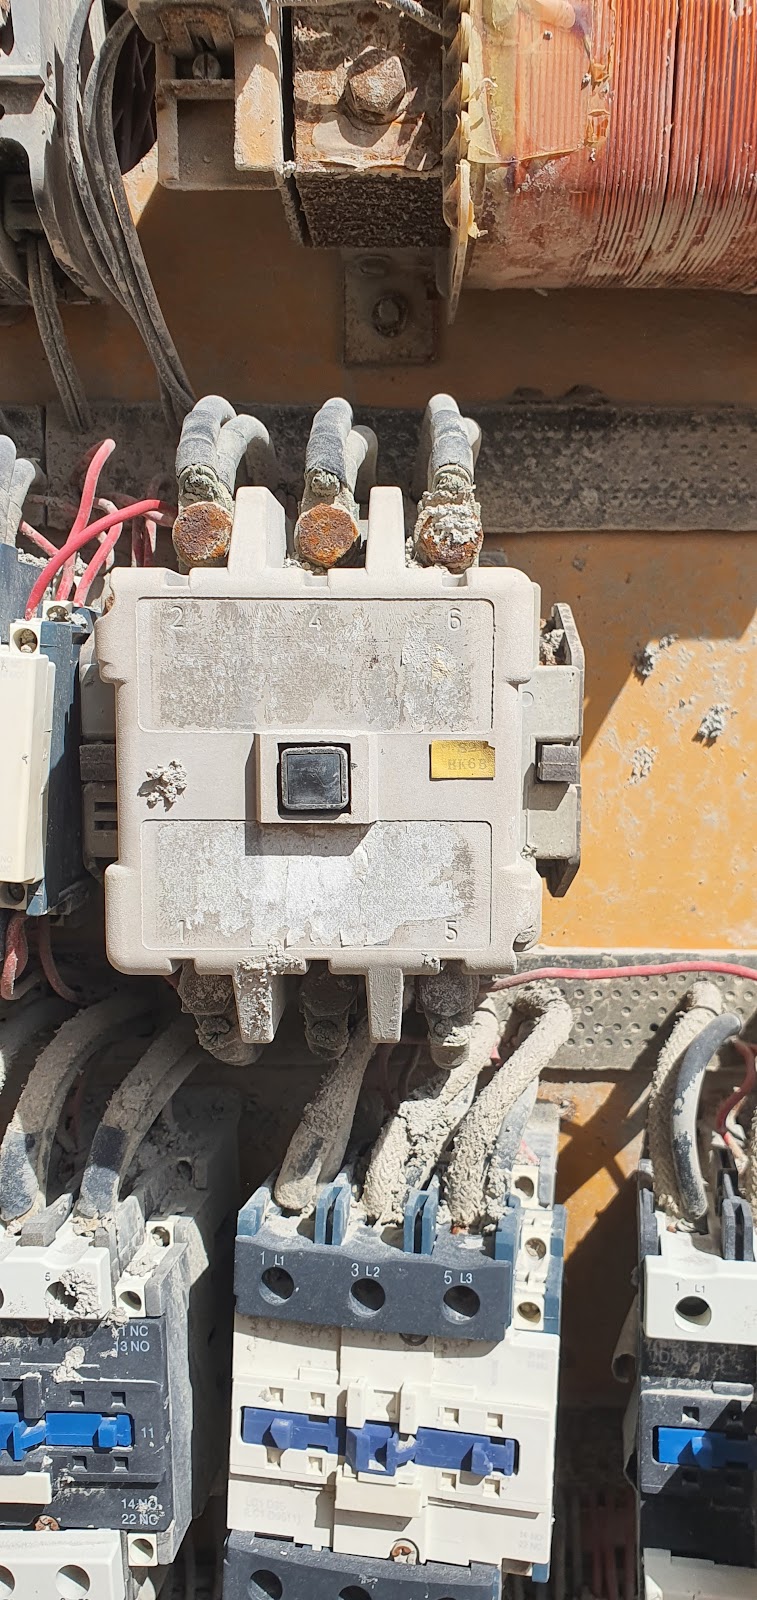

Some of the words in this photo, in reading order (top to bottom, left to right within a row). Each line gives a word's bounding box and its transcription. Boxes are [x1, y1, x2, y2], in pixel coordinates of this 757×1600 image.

[169, 606, 185, 630] 2
[308, 607, 323, 632] 4
[448, 607, 463, 632] 6
[444, 920, 458, 943] 5
[260, 1251, 266, 1265] 1
[274, 1254, 285, 1266] L1
[351, 1263, 359, 1277] 3
[365, 1266, 380, 1277] L2
[443, 1270, 453, 1285] 5
[460, 1272, 473, 1284] L3
[675, 1281, 680, 1291] 1
[694, 1284, 706, 1293] L1
[130, 1325, 149, 1337] NC
[113, 1340, 128, 1352] 13
[130, 1340, 150, 1352] NO
[140, 1426, 154, 1439] 11
[121, 1498, 136, 1509] 14
[121, 1513, 137, 1525] 22
[139, 1513, 159, 1526] NC
